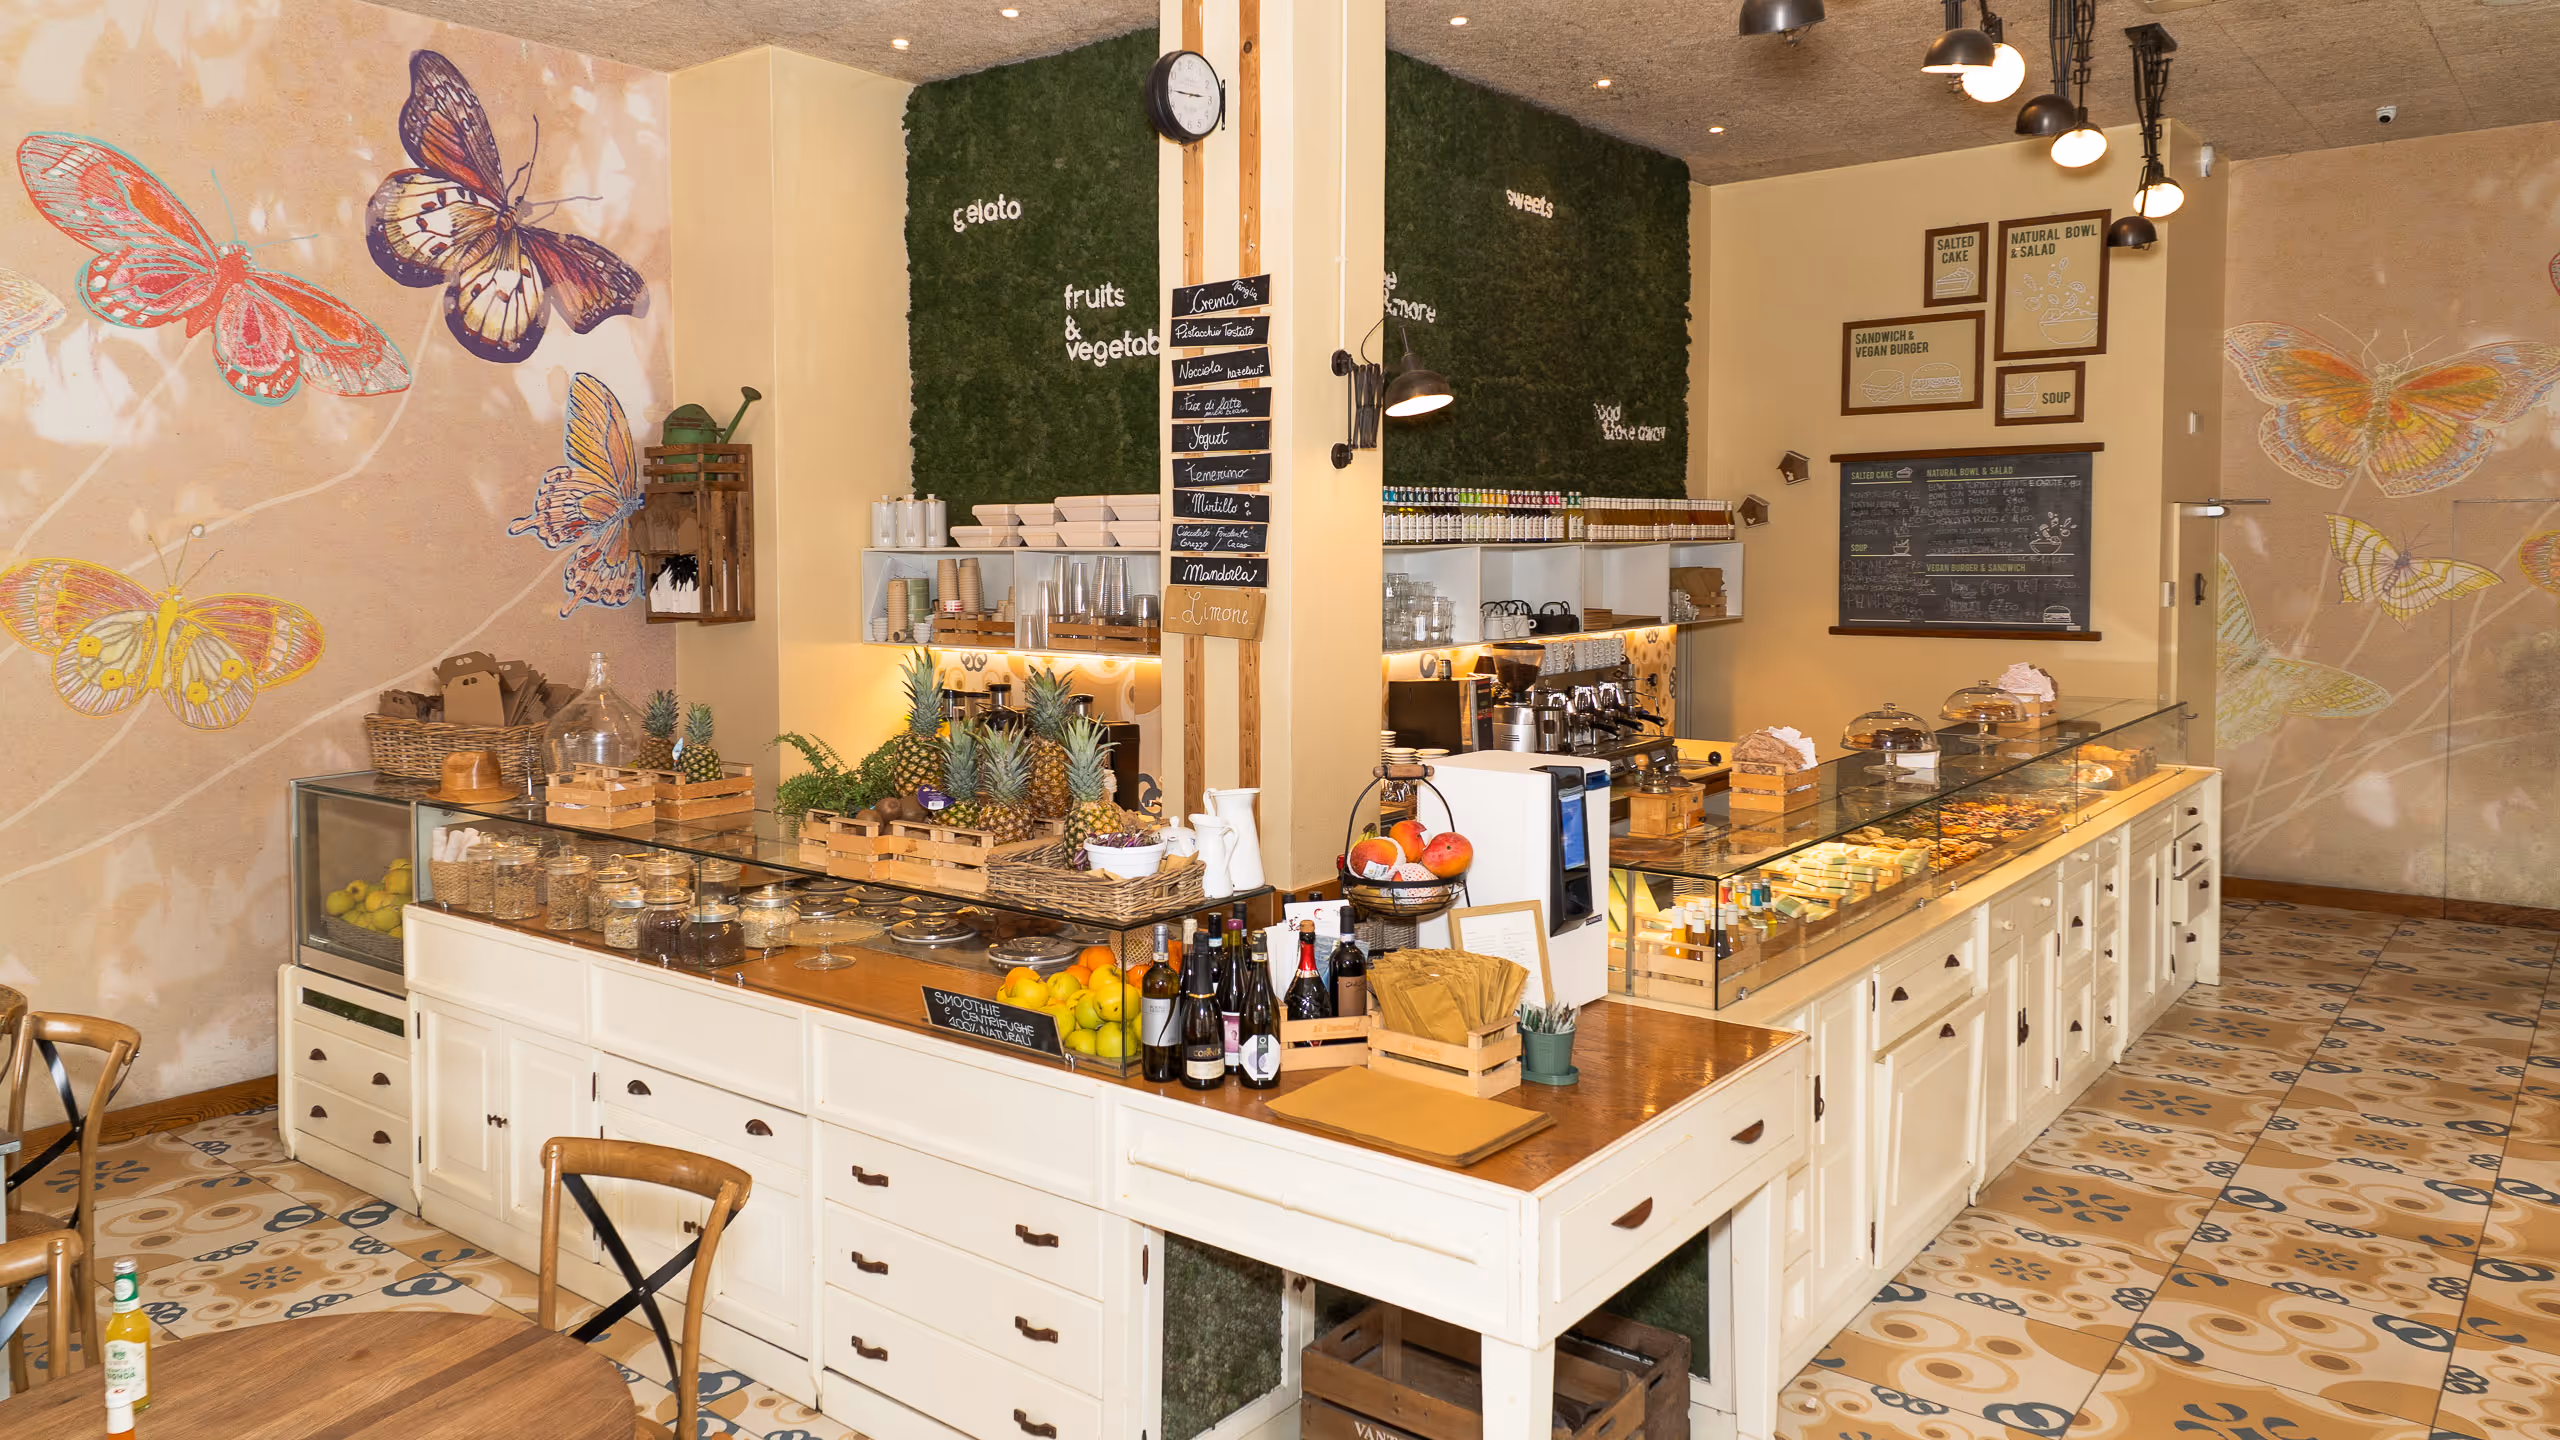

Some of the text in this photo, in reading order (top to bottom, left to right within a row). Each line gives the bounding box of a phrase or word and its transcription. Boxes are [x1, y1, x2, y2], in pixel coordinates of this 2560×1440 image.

[1207, 95, 1213, 105] 3
[953, 193, 1022, 233] gelato
[1506, 189, 1554, 219] sweets
[1937, 235, 1974, 251] SALTED
[2011, 224, 2098, 245] NATURAL BOWL
[1941, 250, 1969, 264] CAKE
[2010, 243, 2056, 259] & SALAD
[1064, 281, 1126, 310] fruits
[1190, 288, 1239, 314] Crema
[1393, 298, 1437, 324] more
[1065, 315, 1081, 341] &
[1175, 322, 1255, 339] Pistacchio Tostato
[1855, 330, 1915, 345] SANDWICH &
[1855, 341, 1929, 358] VEGAN BURGER
[1179, 360, 1265, 380] Nocciola hazelnut
[1204, 399, 1215, 411] di
[1216, 397, 1242, 411] latte
[2041, 392, 2071, 404] SOUP
[1189, 425, 1230, 450] Yogurt
[1185, 464, 1249, 482] Tenerino
[1851, 470, 1894, 480] SALTED CAKE
[1926, 466, 2014, 477] NATURAL BOWL & SALAD
[1191, 493, 1239, 514] Mirtillo
[1227, 539, 1251, 549] Cacao
[1850, 544, 1868, 552] SOUP
[1182, 564, 1258, 583] Mandorla
[1926, 563, 1949, 572] VEGAN
[1951, 563, 1979, 572] BURGER
[1988, 563, 2026, 572] SANDWICH
[1181, 591, 1249, 625] Limone
[934, 991, 1000, 1018] SMOOTHIE
[944, 1006, 1035, 1037] e CENTRIFUGHE
[980, 1025, 1032, 1047] NATURALI
